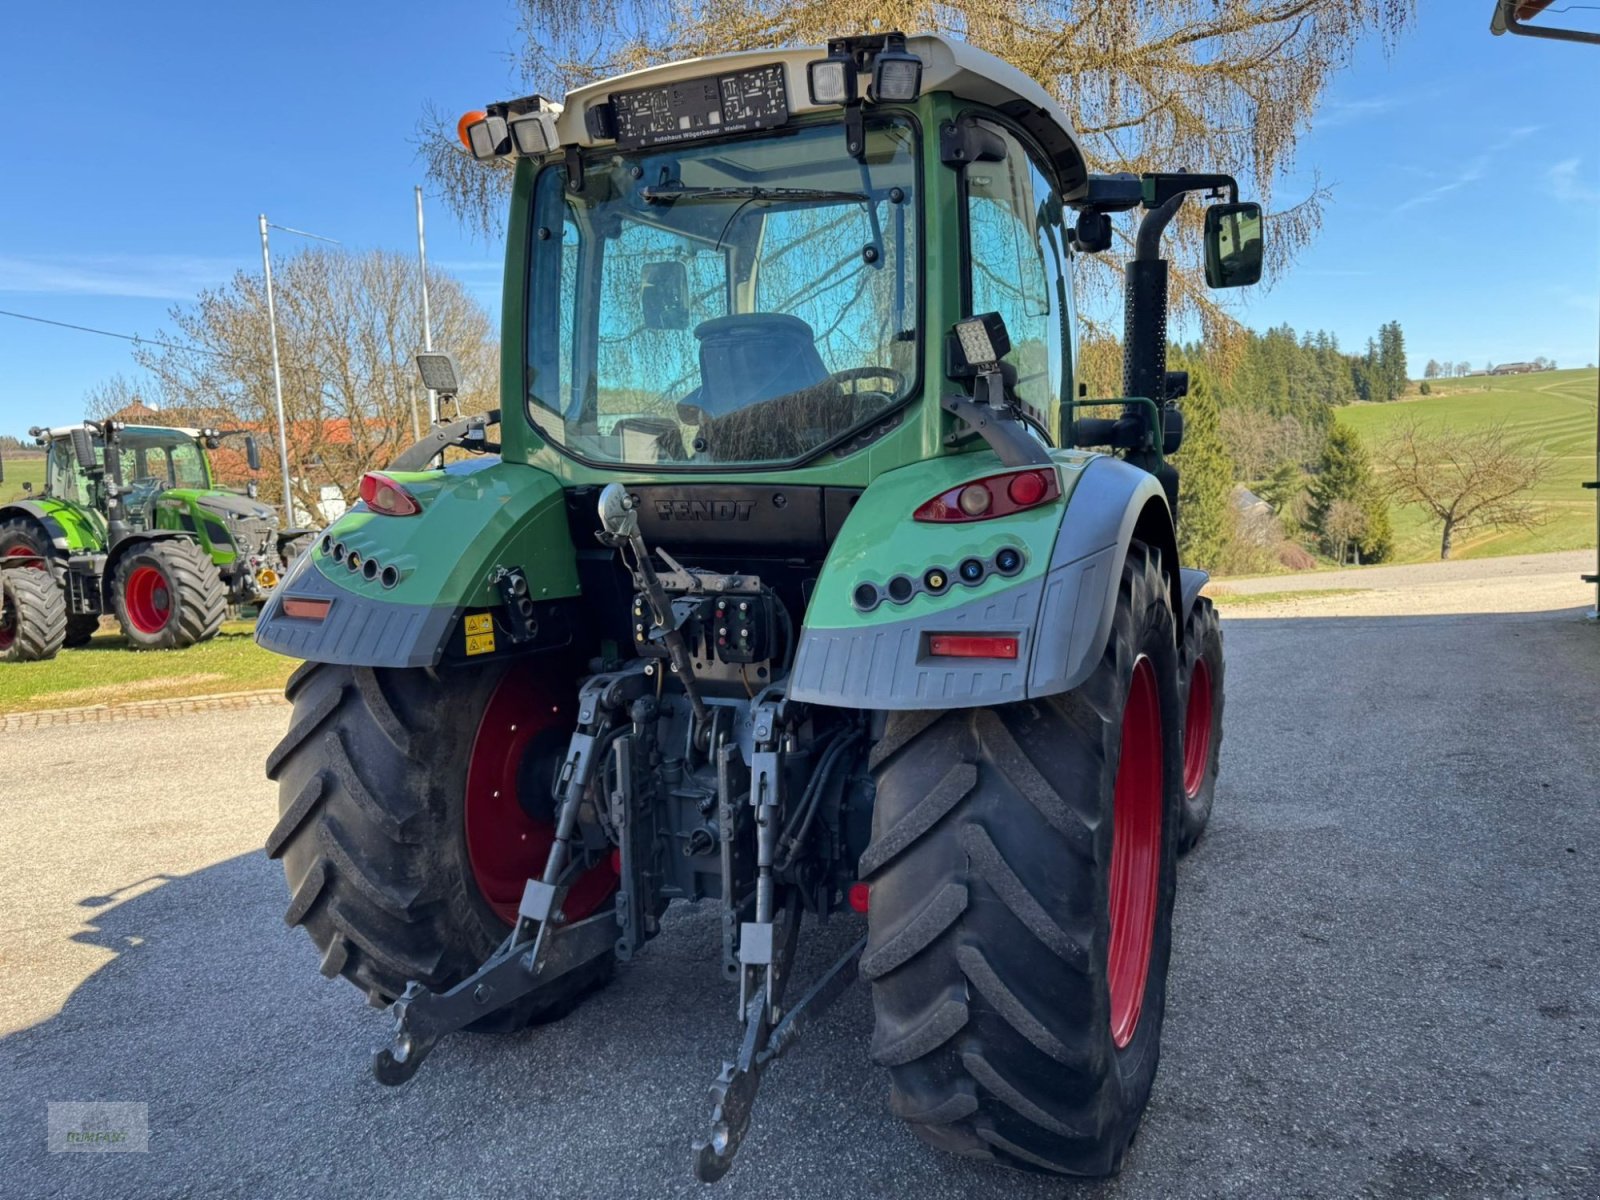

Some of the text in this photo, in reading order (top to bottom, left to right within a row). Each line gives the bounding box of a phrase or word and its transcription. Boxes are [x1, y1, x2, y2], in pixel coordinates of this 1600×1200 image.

[654, 124, 747, 142] Autohaus Wögerbauer Walding
[655, 500, 757, 521] FENDT
